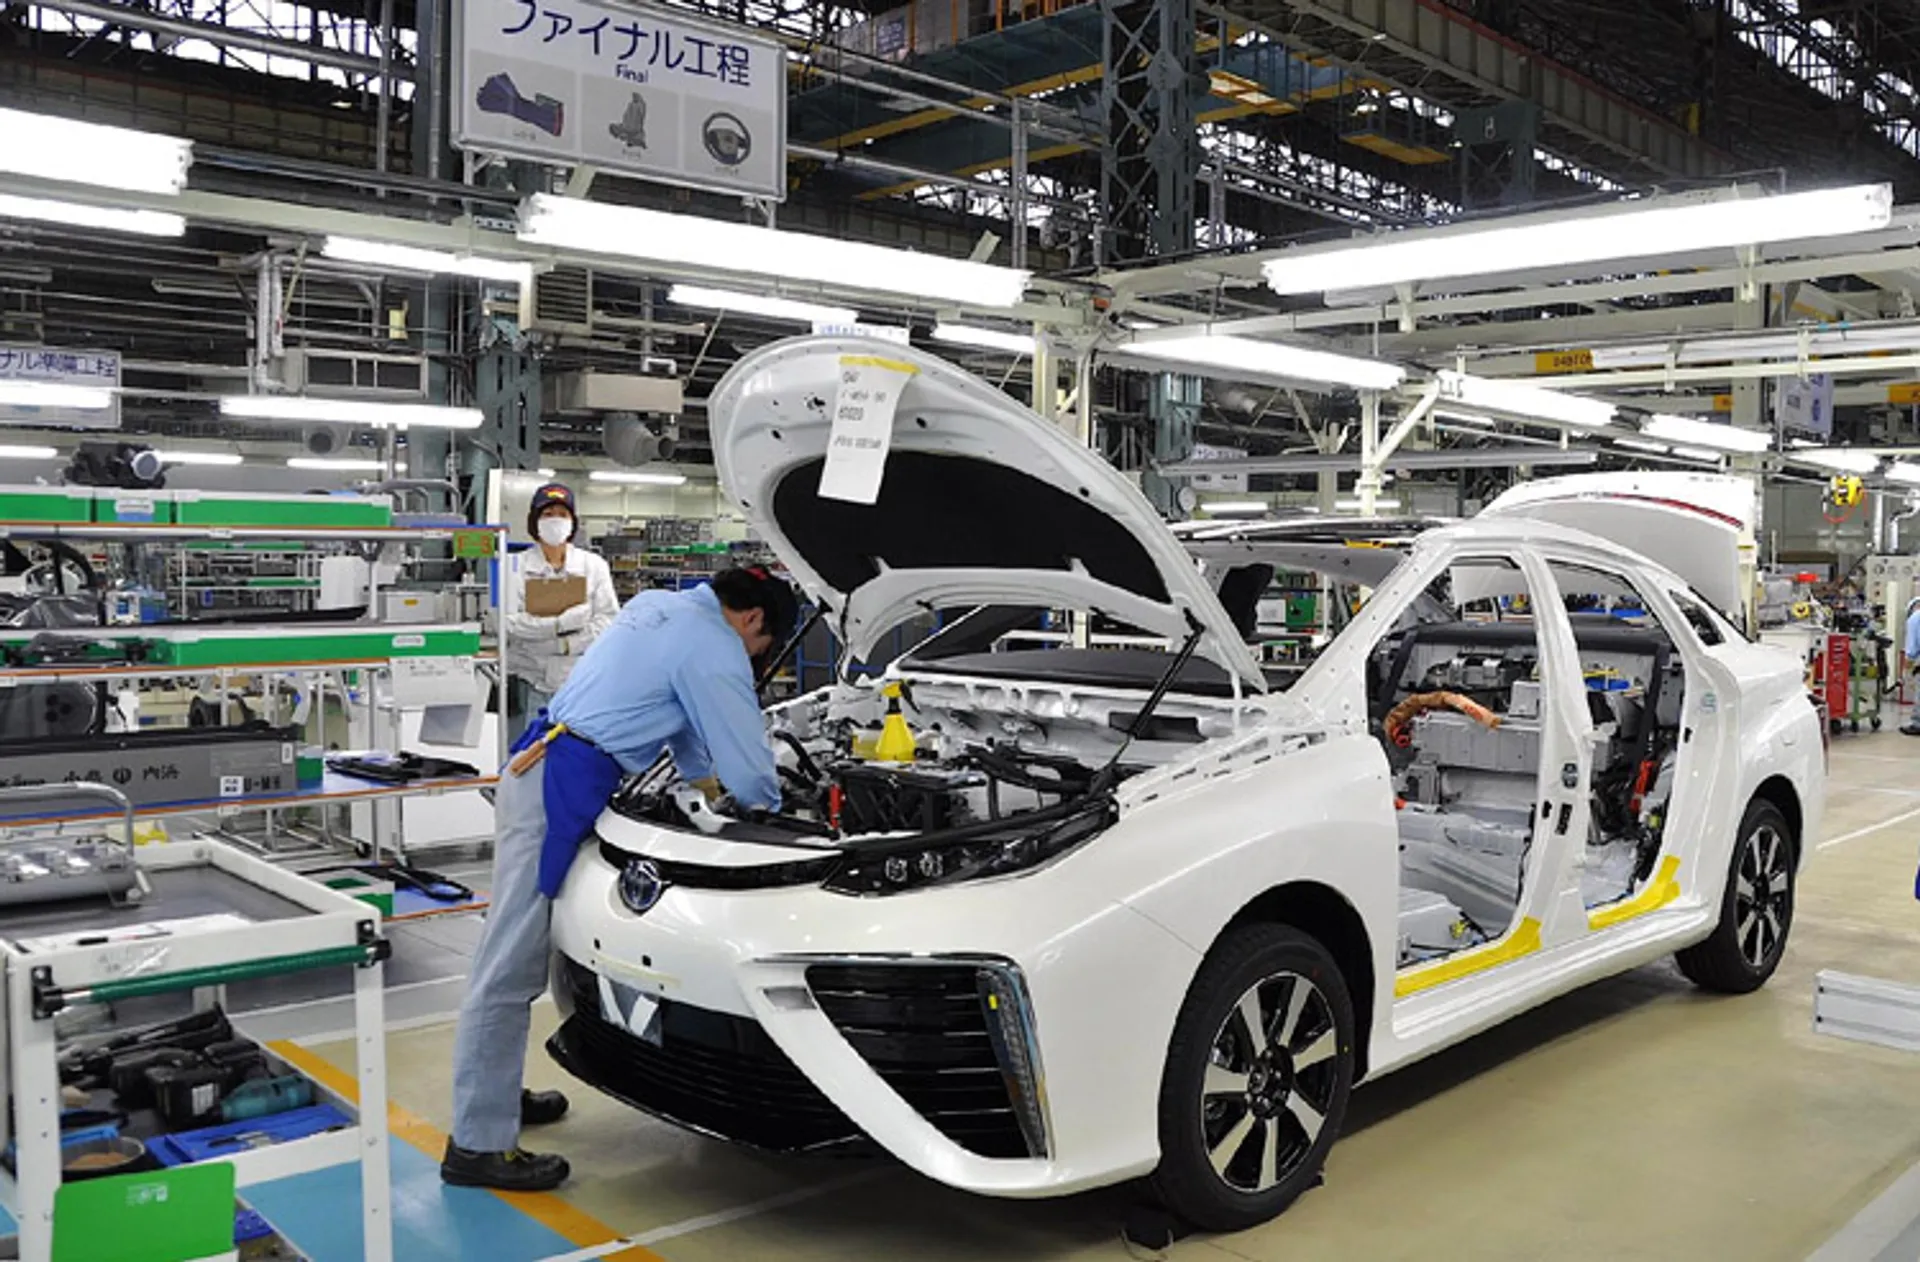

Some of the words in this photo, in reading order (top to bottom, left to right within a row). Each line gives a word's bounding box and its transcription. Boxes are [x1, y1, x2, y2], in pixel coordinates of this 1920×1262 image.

[501, 0, 750, 87] ファイナル工程
[615, 63, 649, 84] Final
